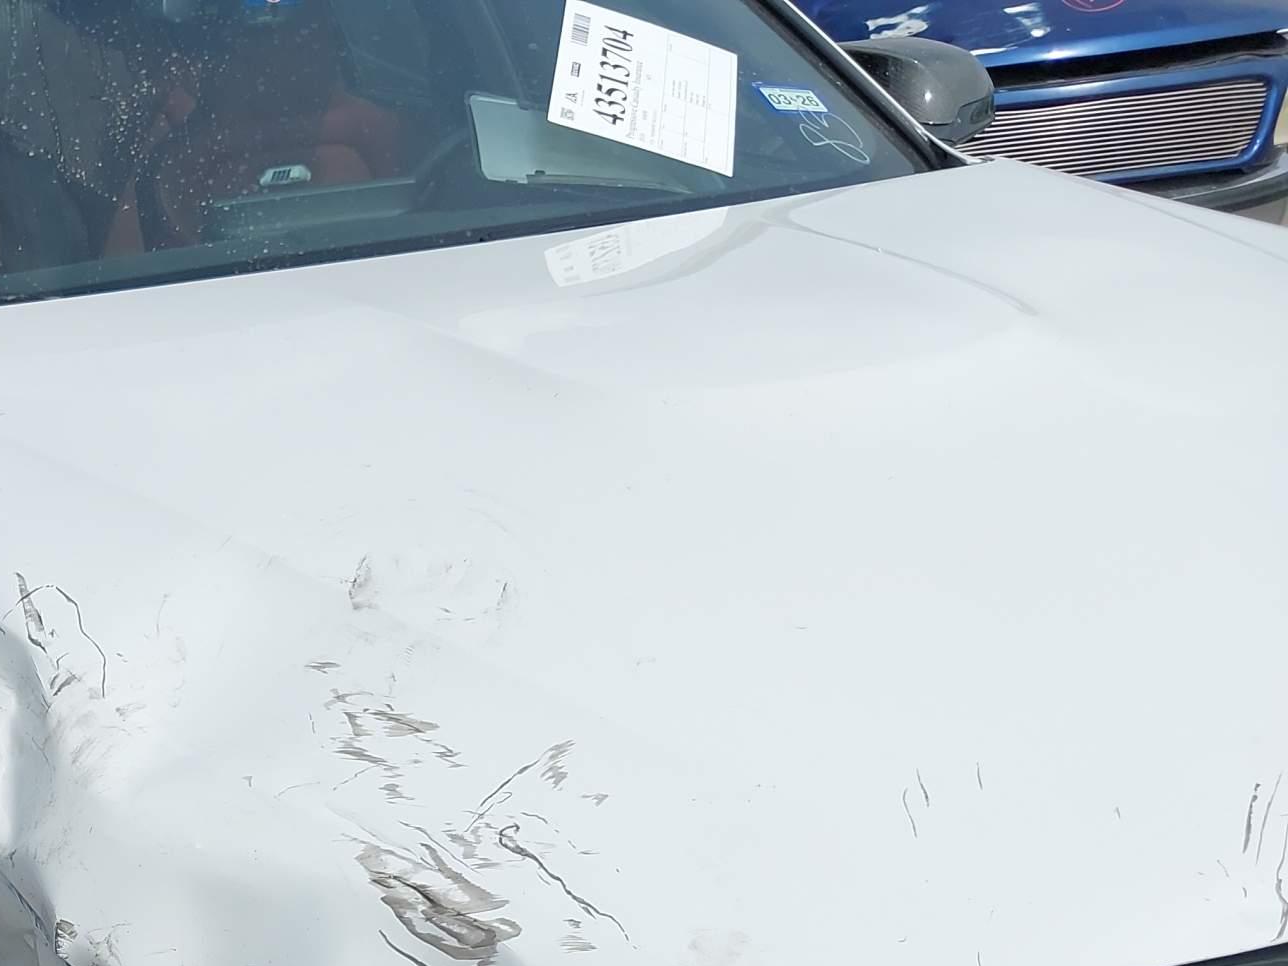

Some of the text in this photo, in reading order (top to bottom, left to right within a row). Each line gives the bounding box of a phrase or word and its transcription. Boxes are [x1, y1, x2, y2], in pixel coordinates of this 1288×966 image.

[592, 24, 634, 125] 43513704
[767, 93, 821, 108] 03 26
